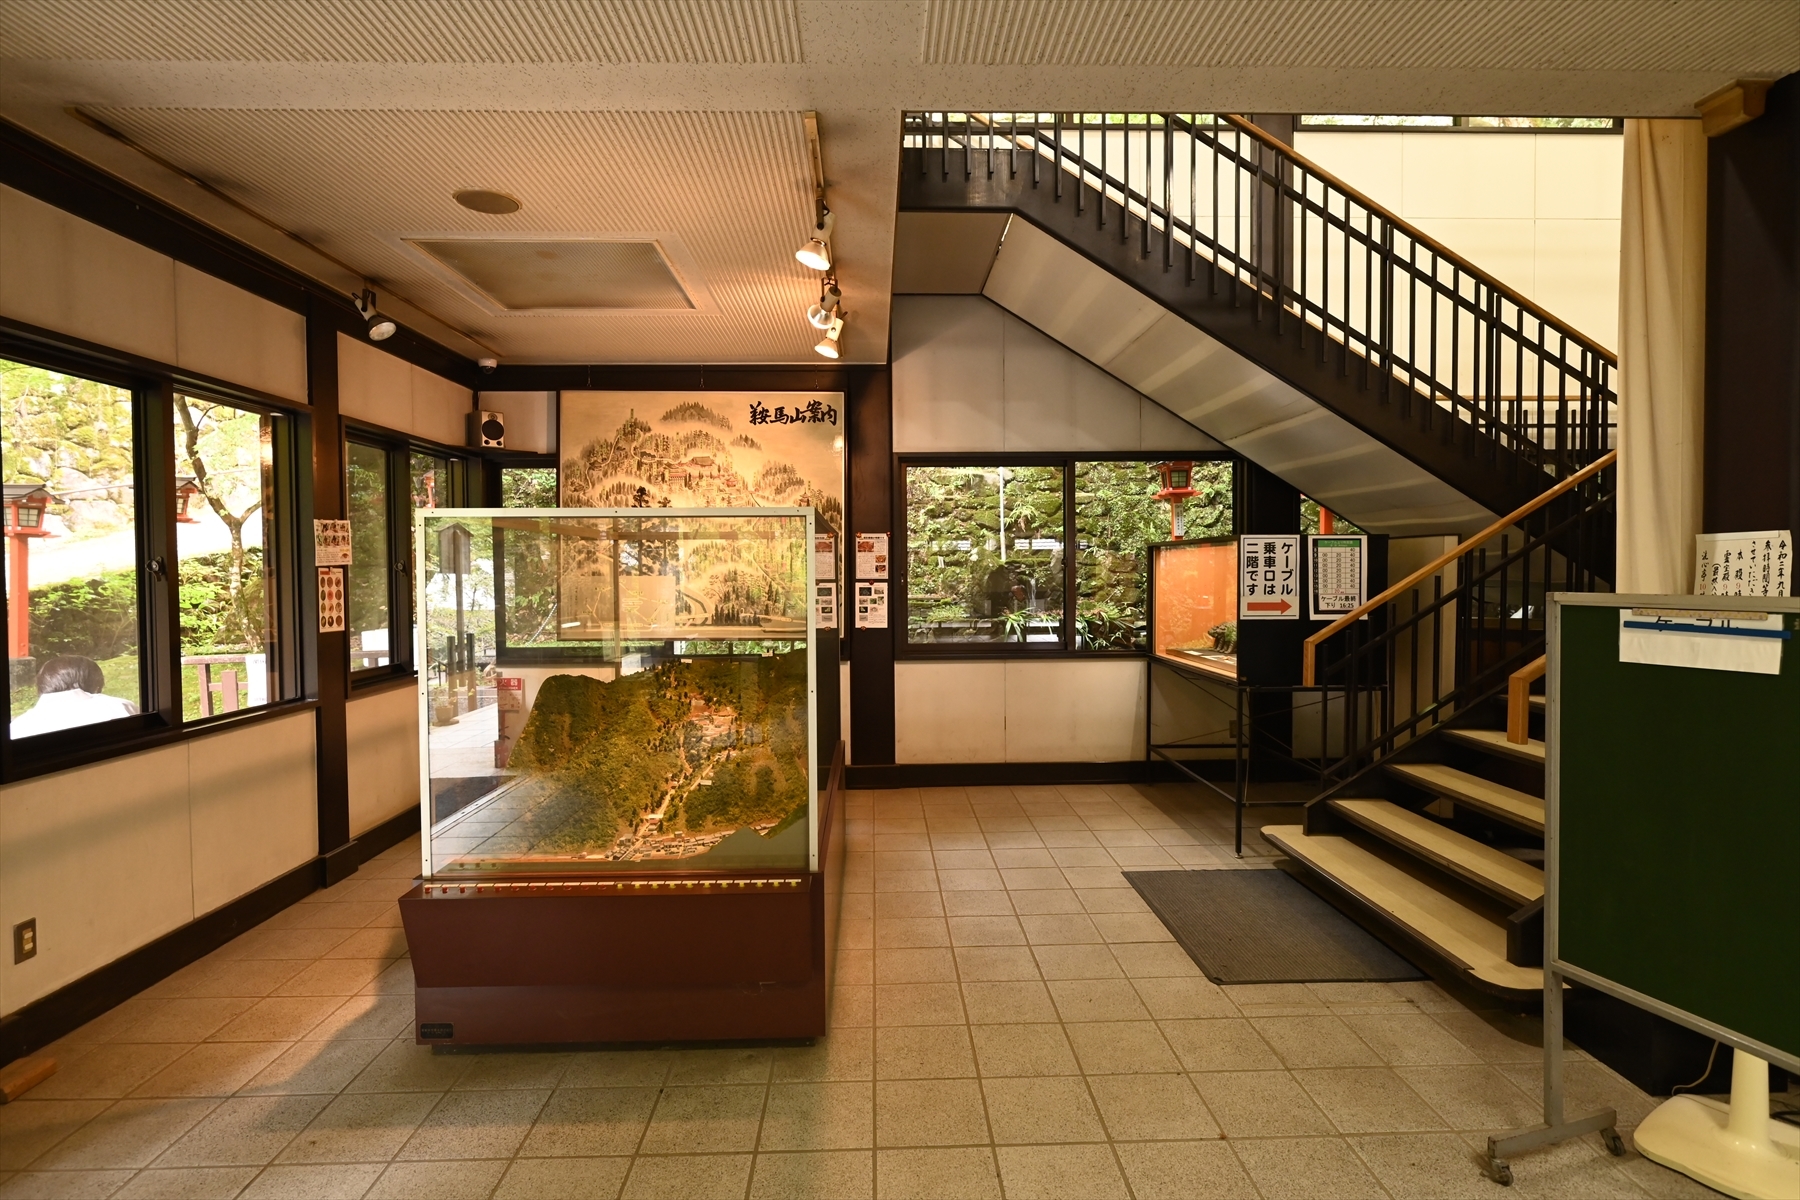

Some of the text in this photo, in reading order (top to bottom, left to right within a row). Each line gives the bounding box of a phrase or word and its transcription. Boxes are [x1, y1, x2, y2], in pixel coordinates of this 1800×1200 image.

[749, 399, 838, 426] 鞍馬山案内
[1246, 542, 1259, 596] 二階です
[1263, 541, 1276, 595] 乗車口は
[1281, 542, 1294, 595] ケーブル
